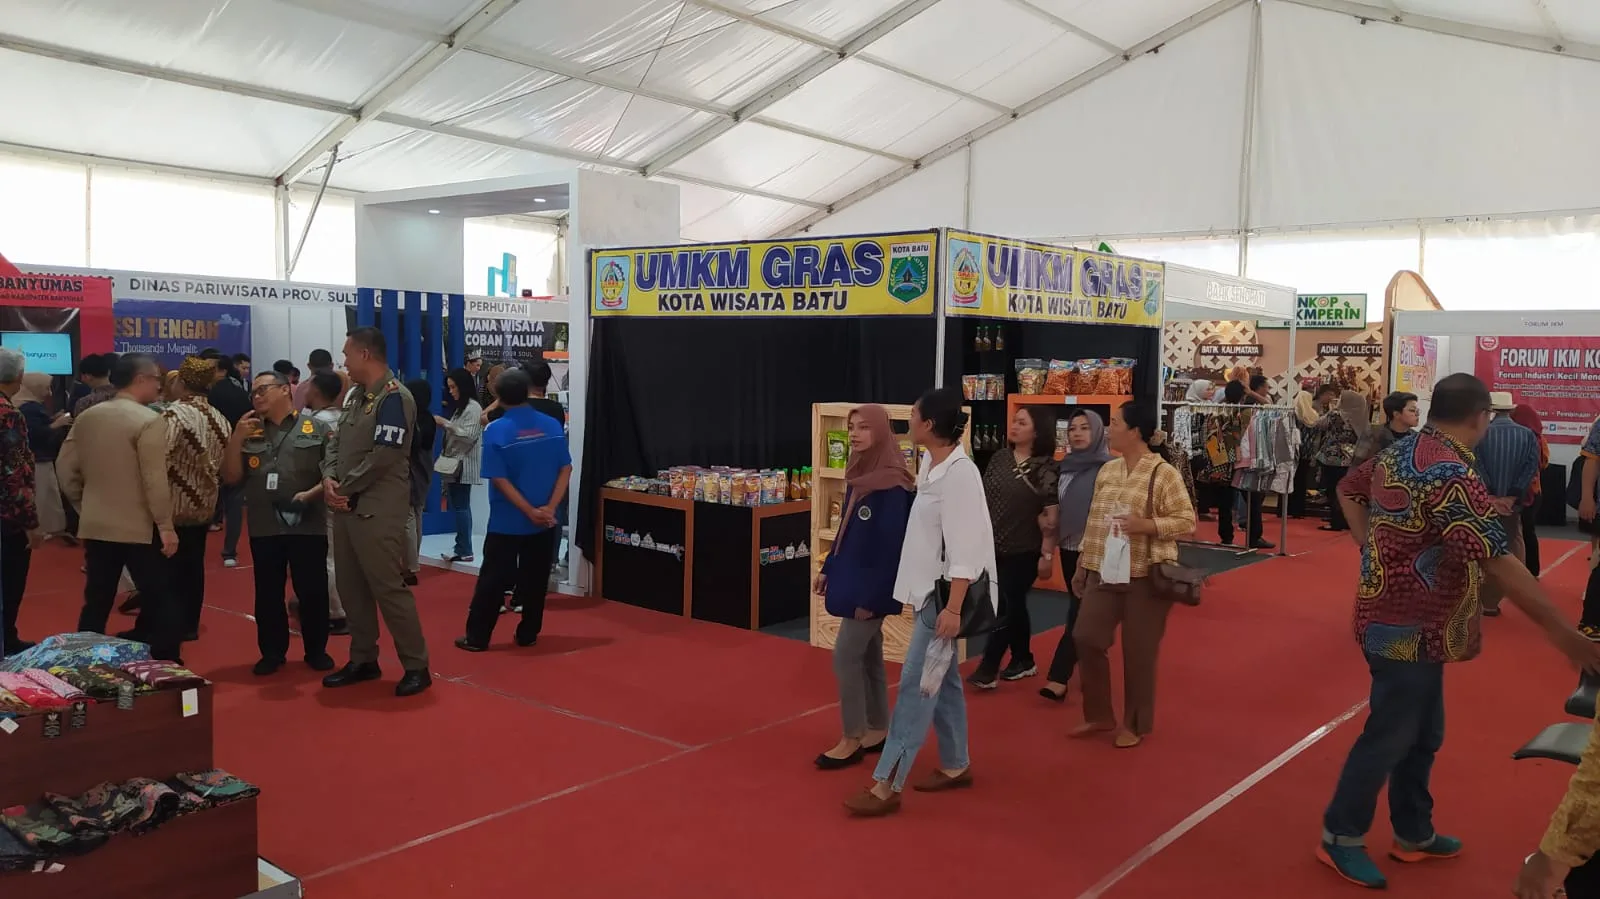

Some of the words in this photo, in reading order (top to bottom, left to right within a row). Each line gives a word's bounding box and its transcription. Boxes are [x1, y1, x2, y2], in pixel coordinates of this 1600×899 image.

[892, 246, 910, 254] KOTA
[633, 245, 750, 291] UMKM
[761, 241, 885, 290] GRAS
[986, 241, 1074, 295] UMKM
[1080, 256, 1144, 300] GRAS
[130, 278, 180, 292] DINAS
[185, 281, 278, 298] PARIWISATA
[282, 288, 324, 302] PROV.
[470, 301, 528, 314] PERHUTANI
[658, 293, 705, 312] KOTA
[710, 291, 786, 312] WISATA
[792, 291, 848, 311] BATU
[1008, 292, 1043, 314] KOTA
[1048, 296, 1093, 318] WISATA
[1097, 300, 1127, 320] BATU
[147, 318, 219, 339] TENGAH
[464, 319, 497, 332] WANA
[501, 320, 545, 332] WISATA
[465, 334, 502, 346] COBAN
[505, 335, 542, 347] TALUN
[1201, 345, 1219, 353] BATIK
[1320, 345, 1339, 354] ADHI
[1500, 348, 1549, 367] FORUM
[1553, 348, 1580, 368] IKM
[1499, 371, 1523, 379] Forum
[1525, 371, 1555, 380] Industri
[1557, 371, 1578, 380] Kecil
[374, 425, 406, 445] PTI
